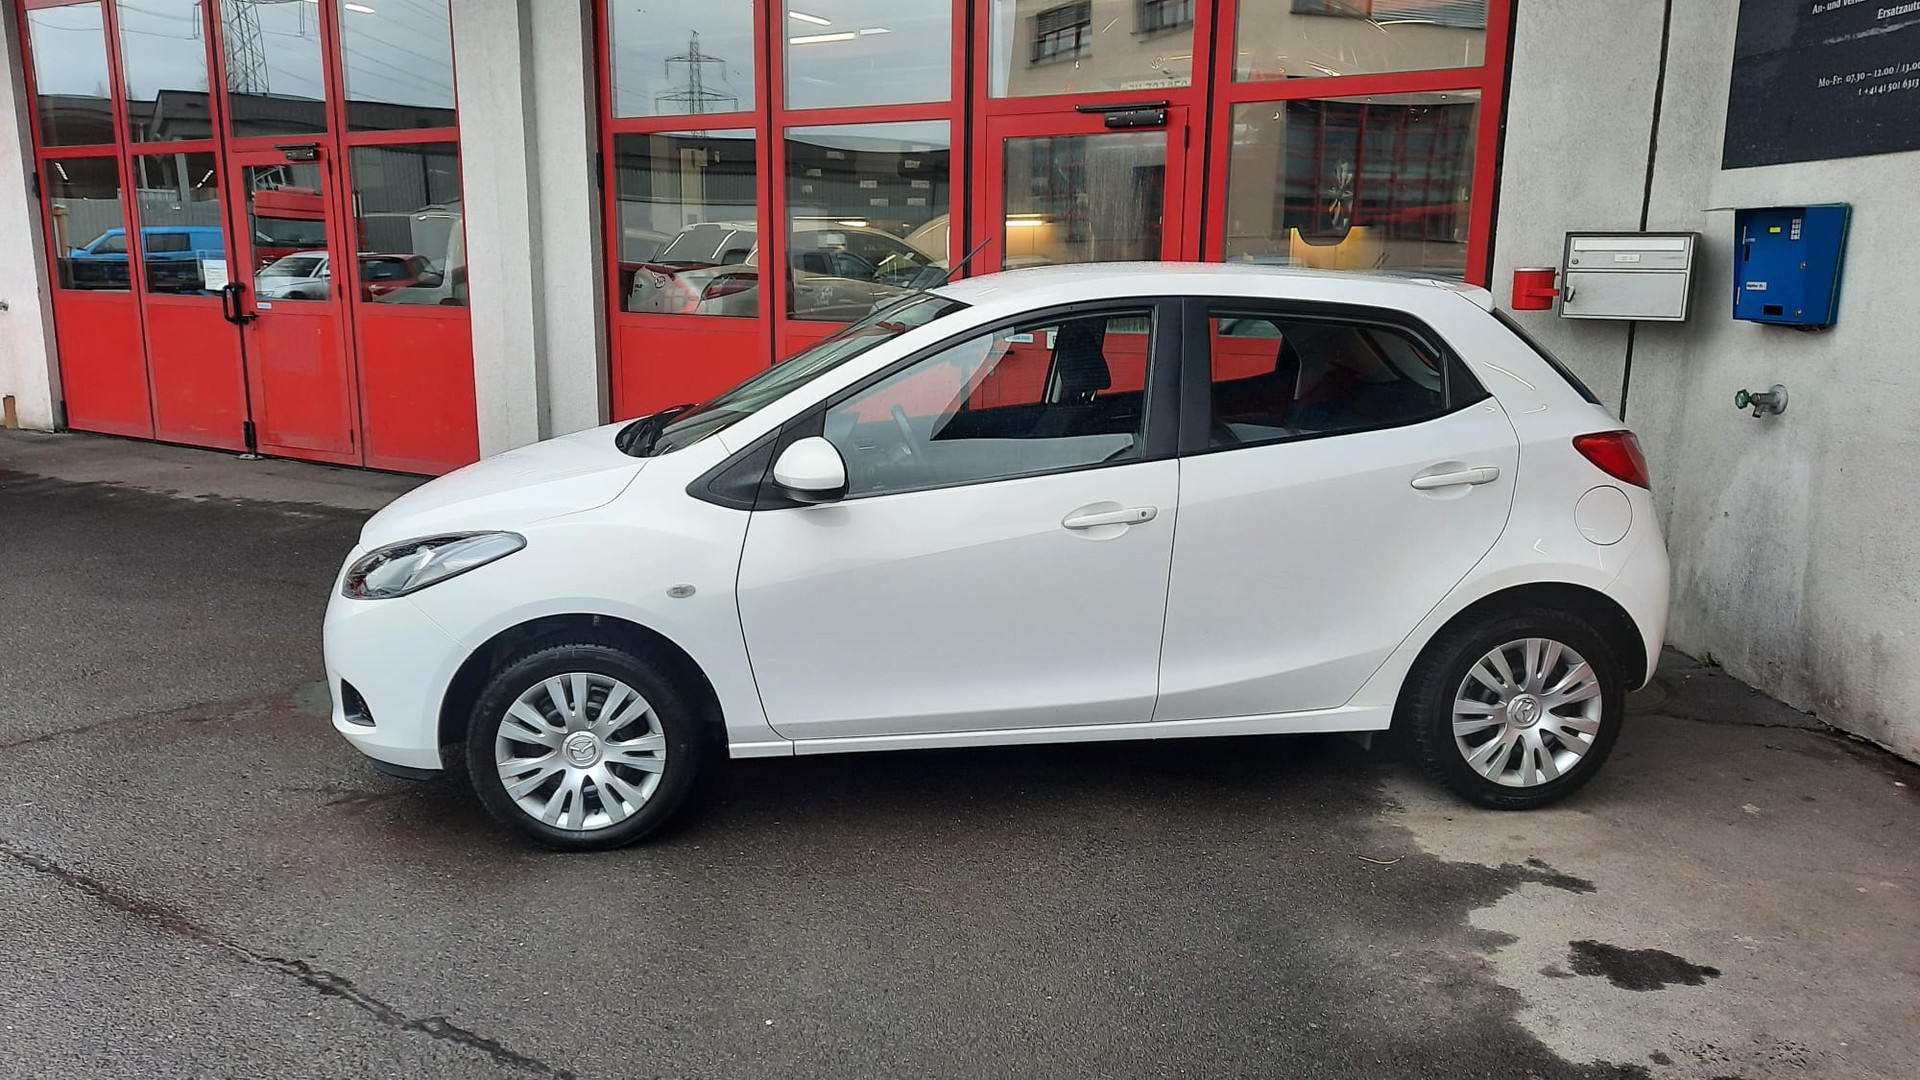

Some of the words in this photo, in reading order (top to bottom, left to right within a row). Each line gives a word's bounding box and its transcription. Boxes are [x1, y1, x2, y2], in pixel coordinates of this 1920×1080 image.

[1812, 4, 1825, 14] An-
[1827, 0, 1841, 10] und
[1874, 66, 1895, 77] 12.00
